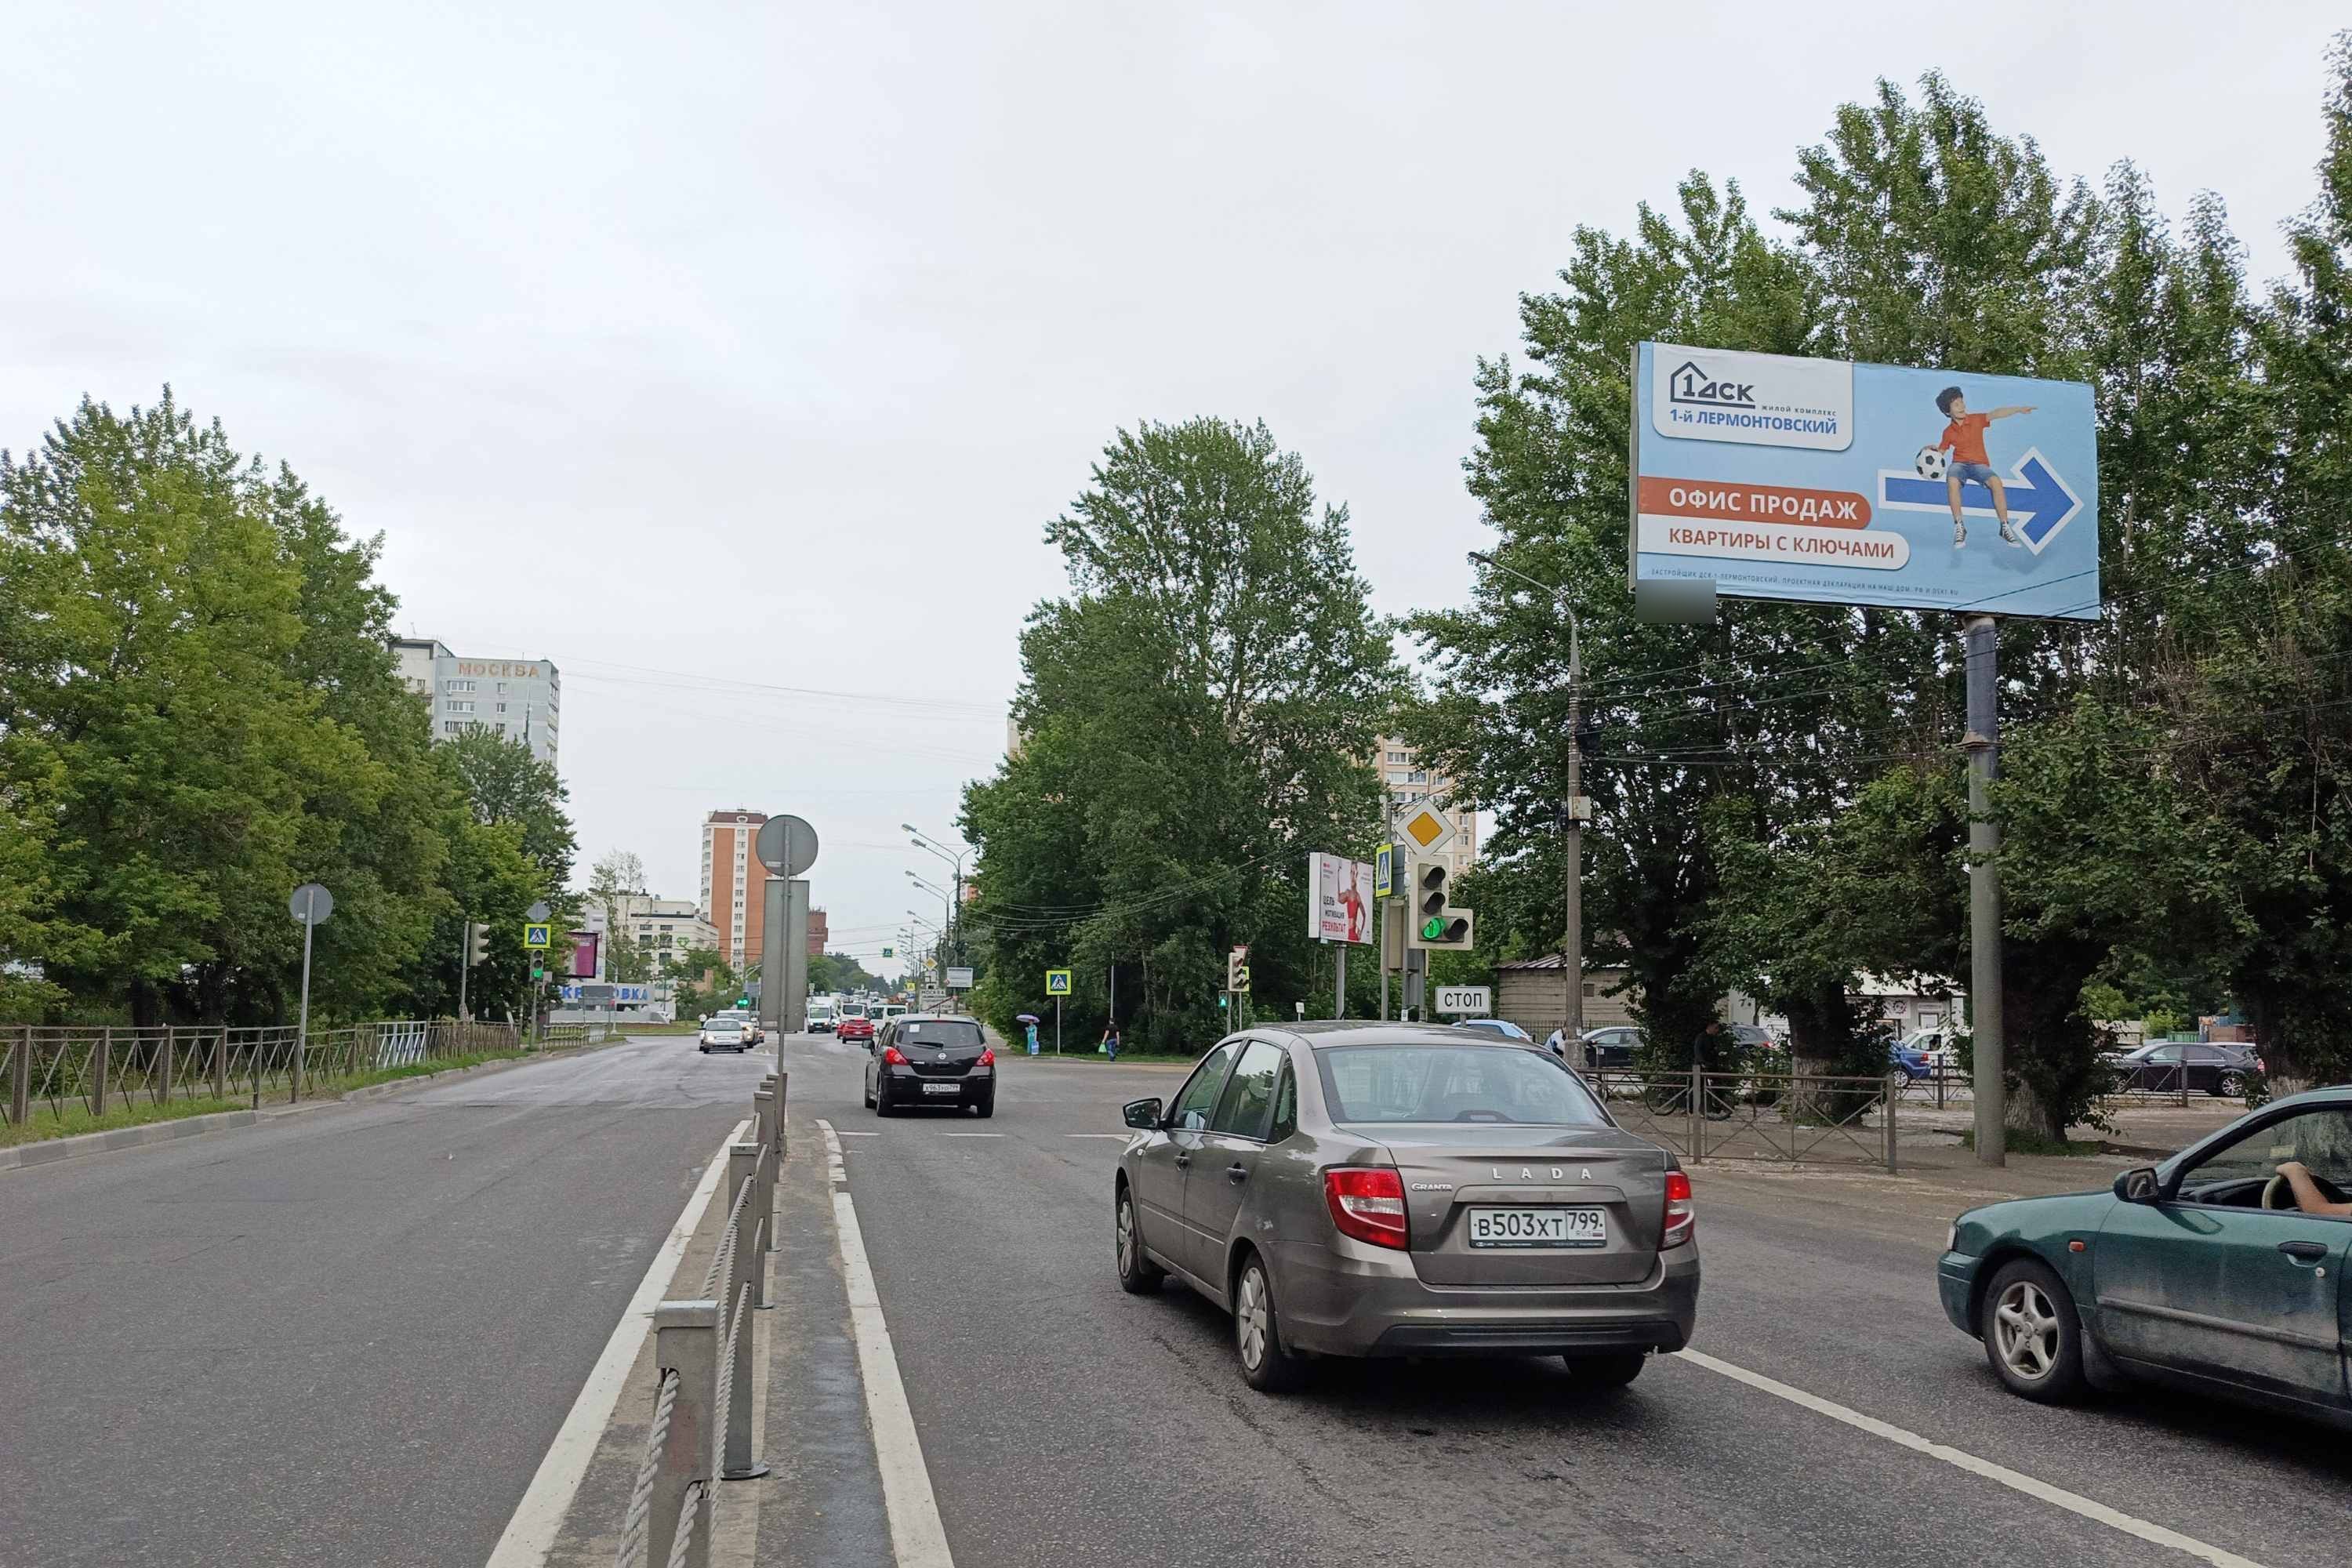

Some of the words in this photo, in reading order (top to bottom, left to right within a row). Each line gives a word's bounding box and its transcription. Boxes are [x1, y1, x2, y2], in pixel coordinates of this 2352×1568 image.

[1670, 408, 1693, 423] 1-й
[1696, 411, 1837, 435] ЛЕРМОНТОВСКИЙ
[1668, 487, 1742, 512] ОФИС
[1749, 493, 1858, 522] ПРОДАЖ
[1669, 528, 1770, 550] КВАРТИРЫ
[1776, 535, 1788, 551] С
[1793, 538, 1894, 559] КЛЮЧАМИ
[459, 662, 539, 677] МОСКВА
[1444, 993, 1483, 1007] СТОП
[1492, 1167, 1592, 1180] LADA
[1567, 1212, 1599, 1229] 799
